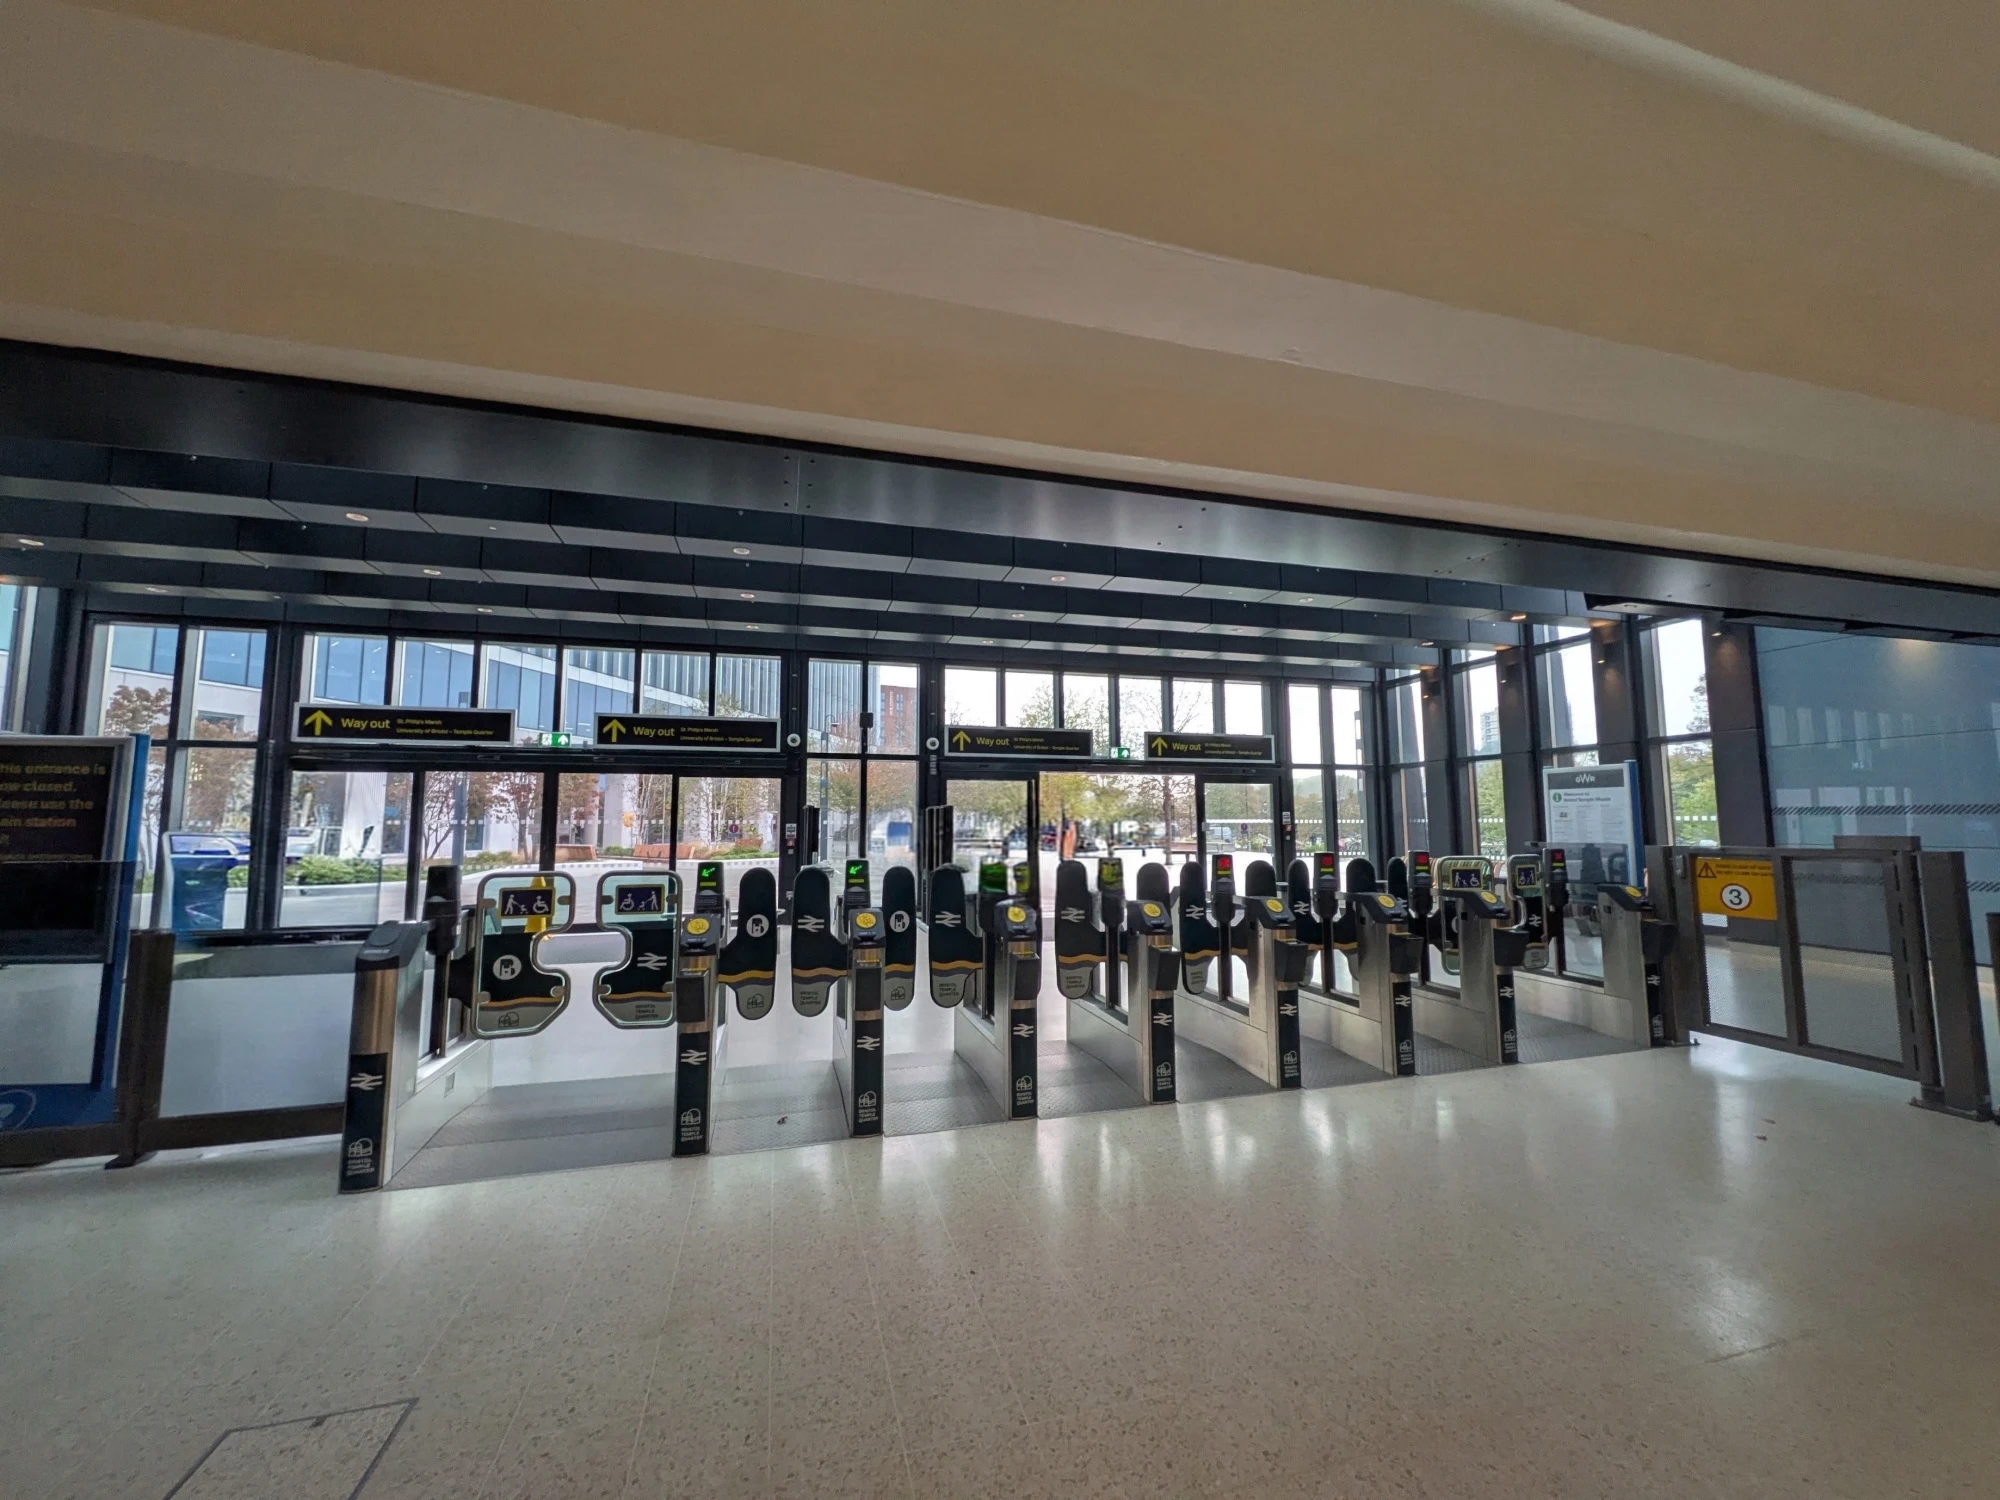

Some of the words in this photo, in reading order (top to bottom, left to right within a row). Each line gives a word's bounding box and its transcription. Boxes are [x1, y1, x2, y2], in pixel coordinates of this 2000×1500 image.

[341, 718, 366, 730] Way
[370, 719, 390, 729] out
[633, 726, 656, 737] Way
[657, 727, 675, 736] out
[976, 737, 994, 747] Way
[995, 738, 1009, 746] out
[1172, 742, 1188, 751] Way
[0, 763, 21, 774] his
[25, 765, 90, 774] entrance
[93, 763, 106, 774] is
[1575, 773, 1596, 784] GWR
[0, 782, 21, 791] ow
[22, 780, 77, 792] closed.
[0, 800, 38, 809] ease
[69, 799, 94, 809] the
[24, 817, 77, 828] station
[1729, 889, 1742, 906] 3
